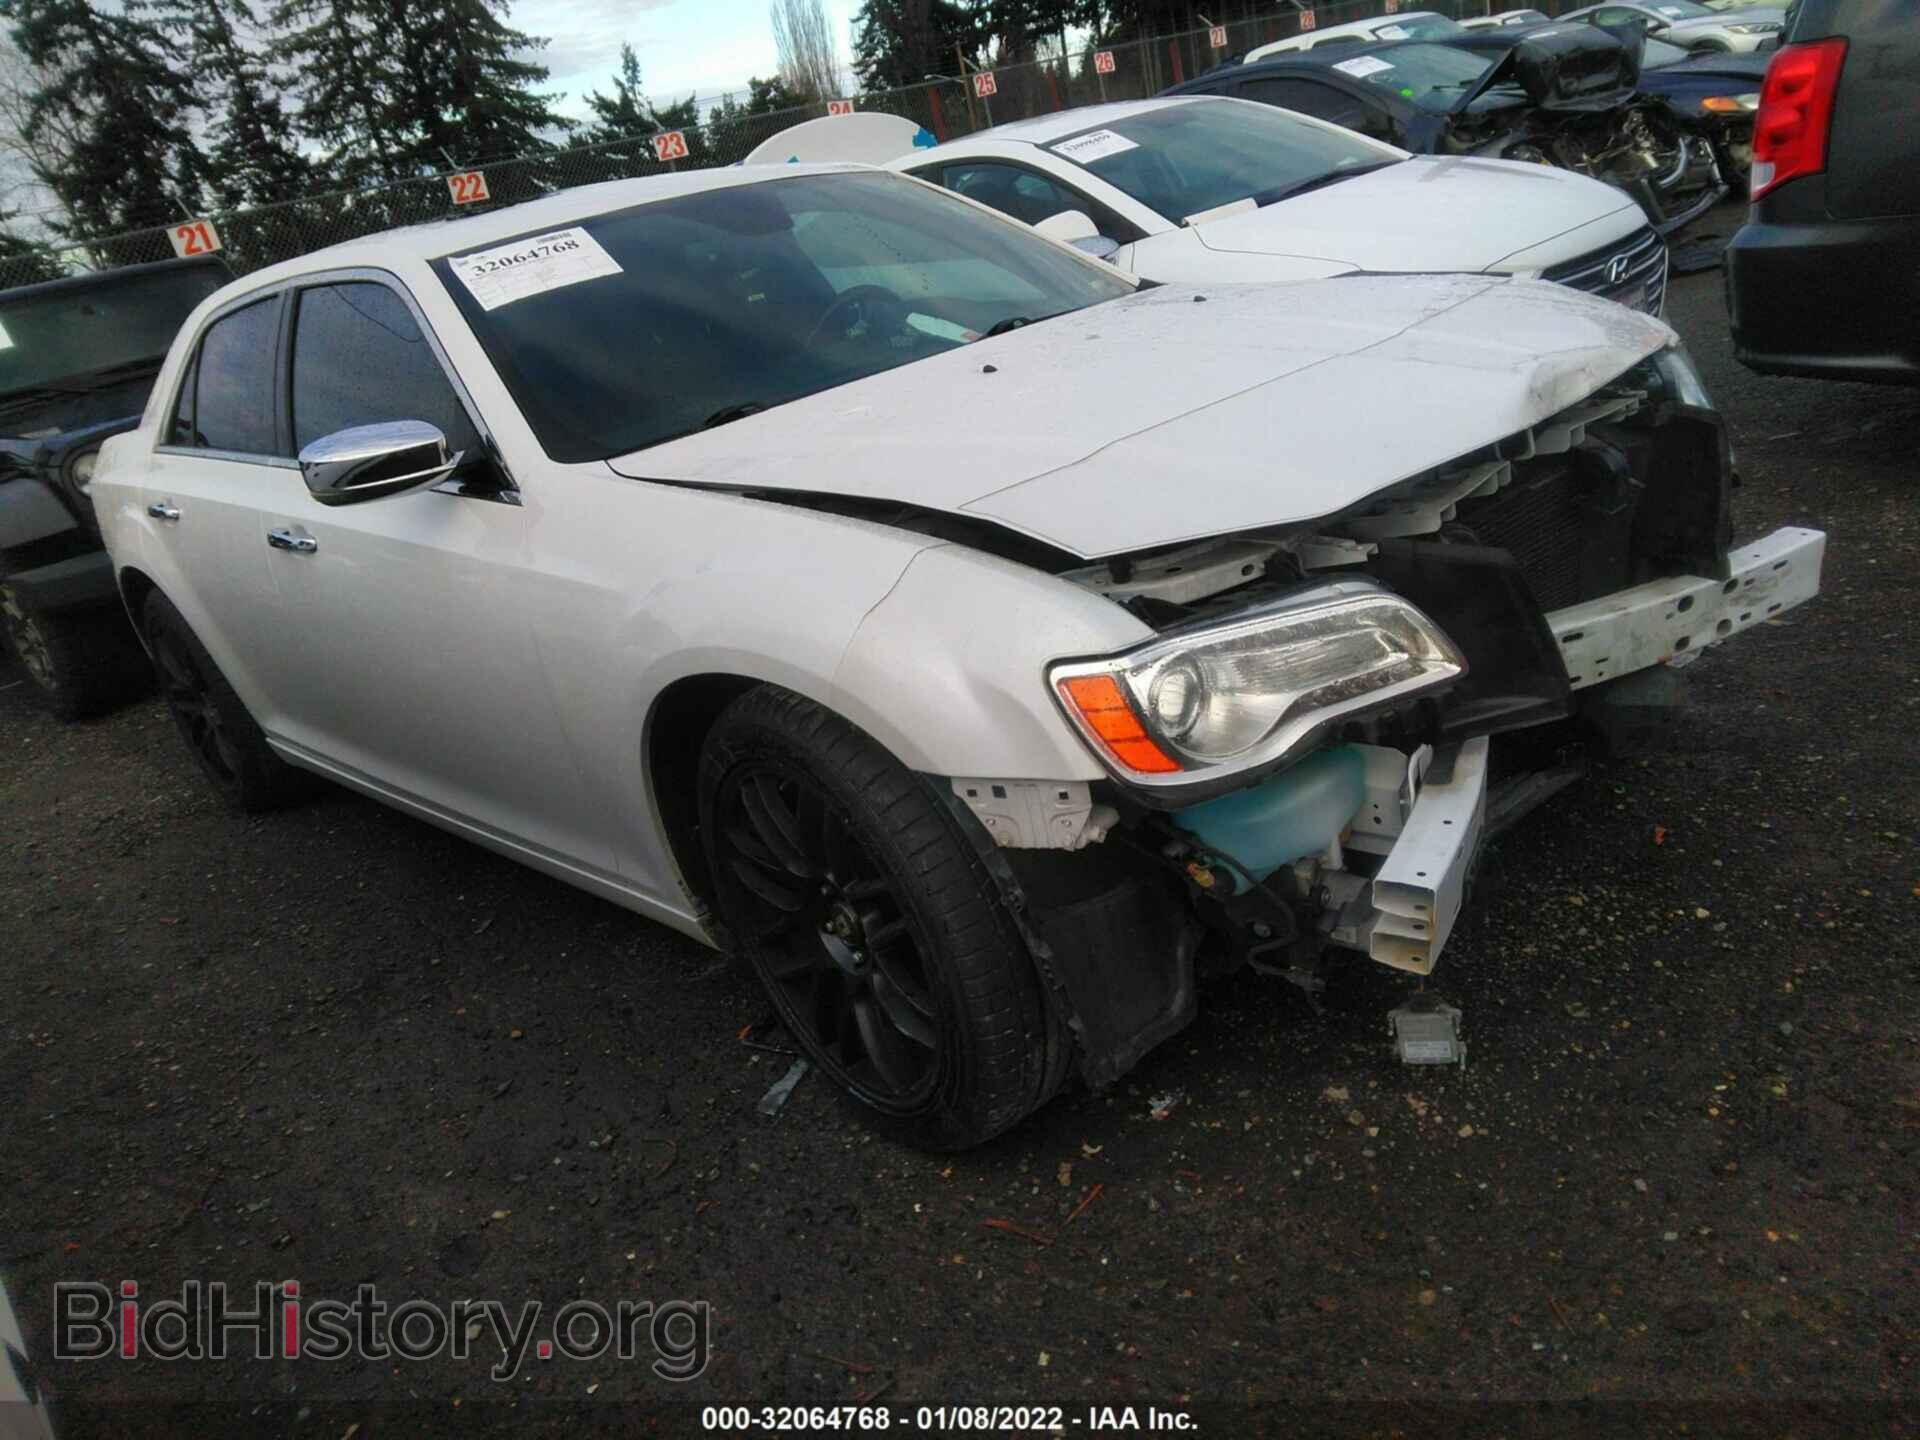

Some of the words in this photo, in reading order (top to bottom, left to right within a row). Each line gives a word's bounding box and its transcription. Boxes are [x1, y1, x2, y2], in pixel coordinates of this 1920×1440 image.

[1096, 52, 1113, 71] 26
[976, 73, 994, 95] 25
[656, 133, 685, 159] 23
[451, 174, 485, 202] 22
[176, 223, 212, 255] 21
[472, 239, 579, 277] 32064768
